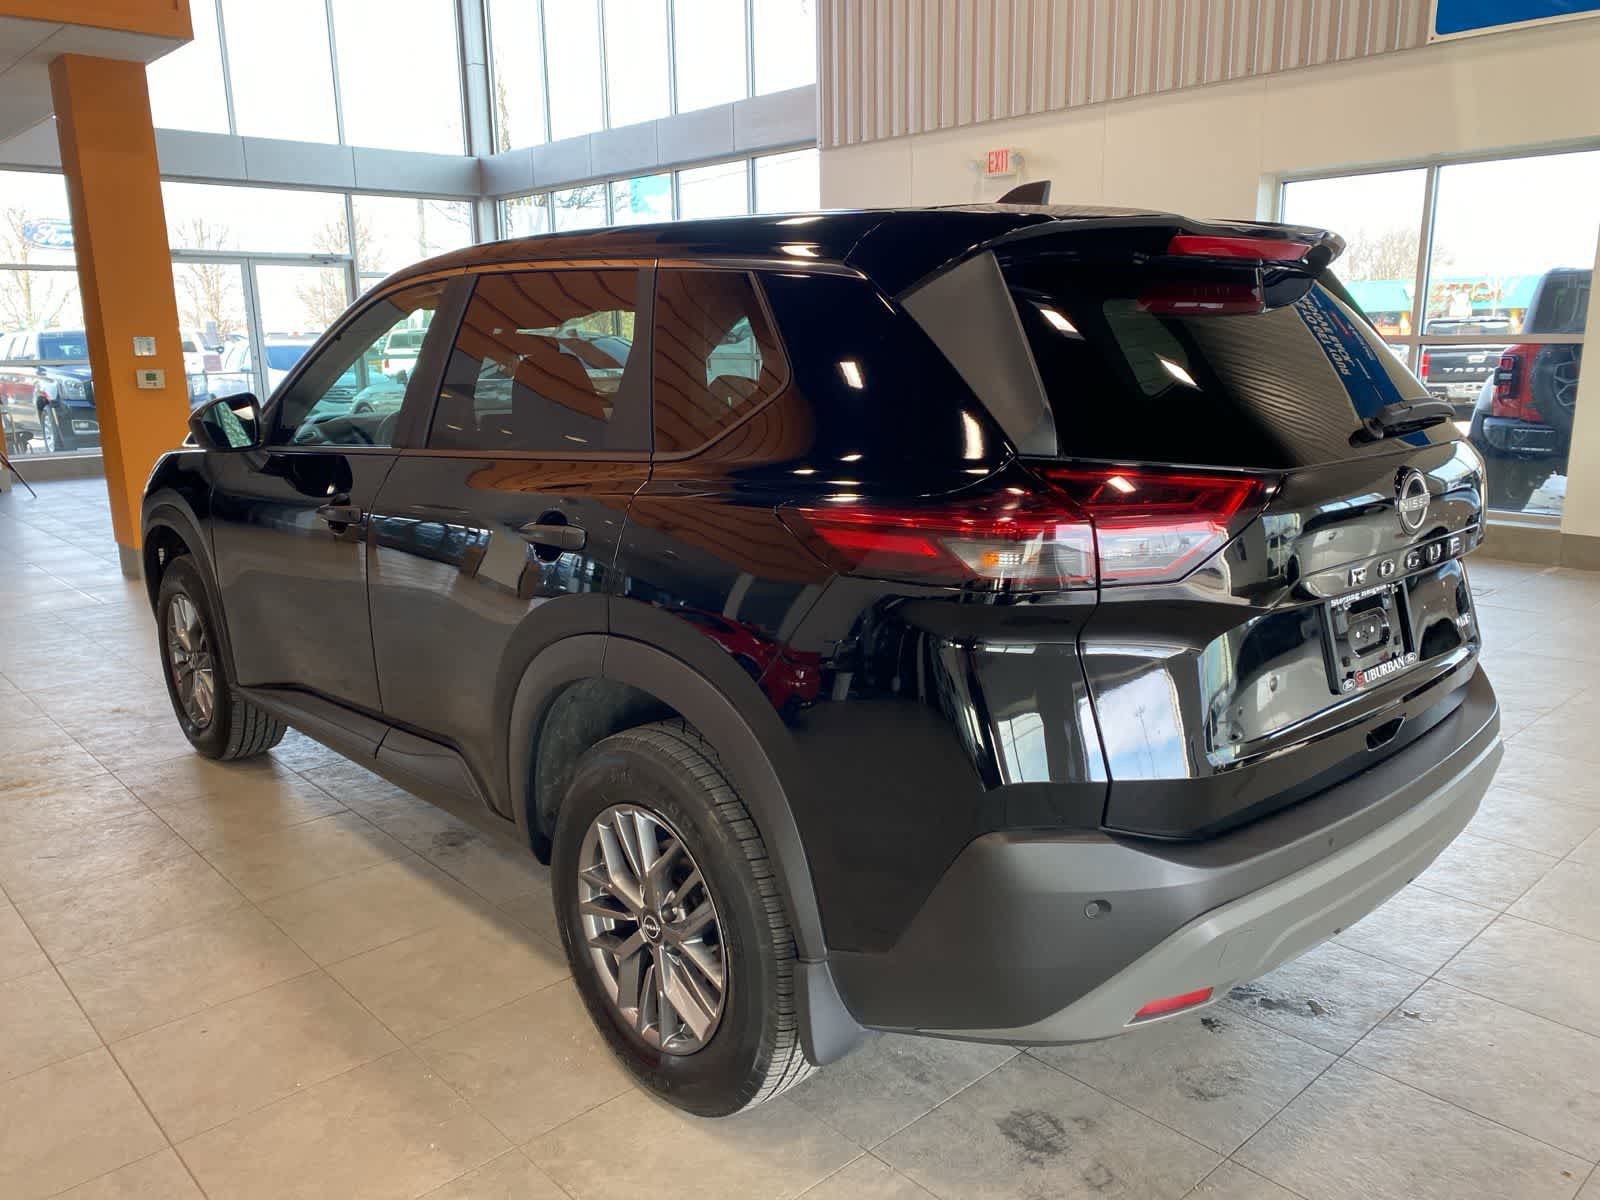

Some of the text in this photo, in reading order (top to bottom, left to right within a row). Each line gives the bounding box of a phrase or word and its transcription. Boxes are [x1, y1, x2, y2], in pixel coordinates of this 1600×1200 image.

[988, 149, 1008, 173] EXIT
[1350, 538, 1463, 586] ROGUE
[1355, 656, 1406, 688] SUBURBAN
